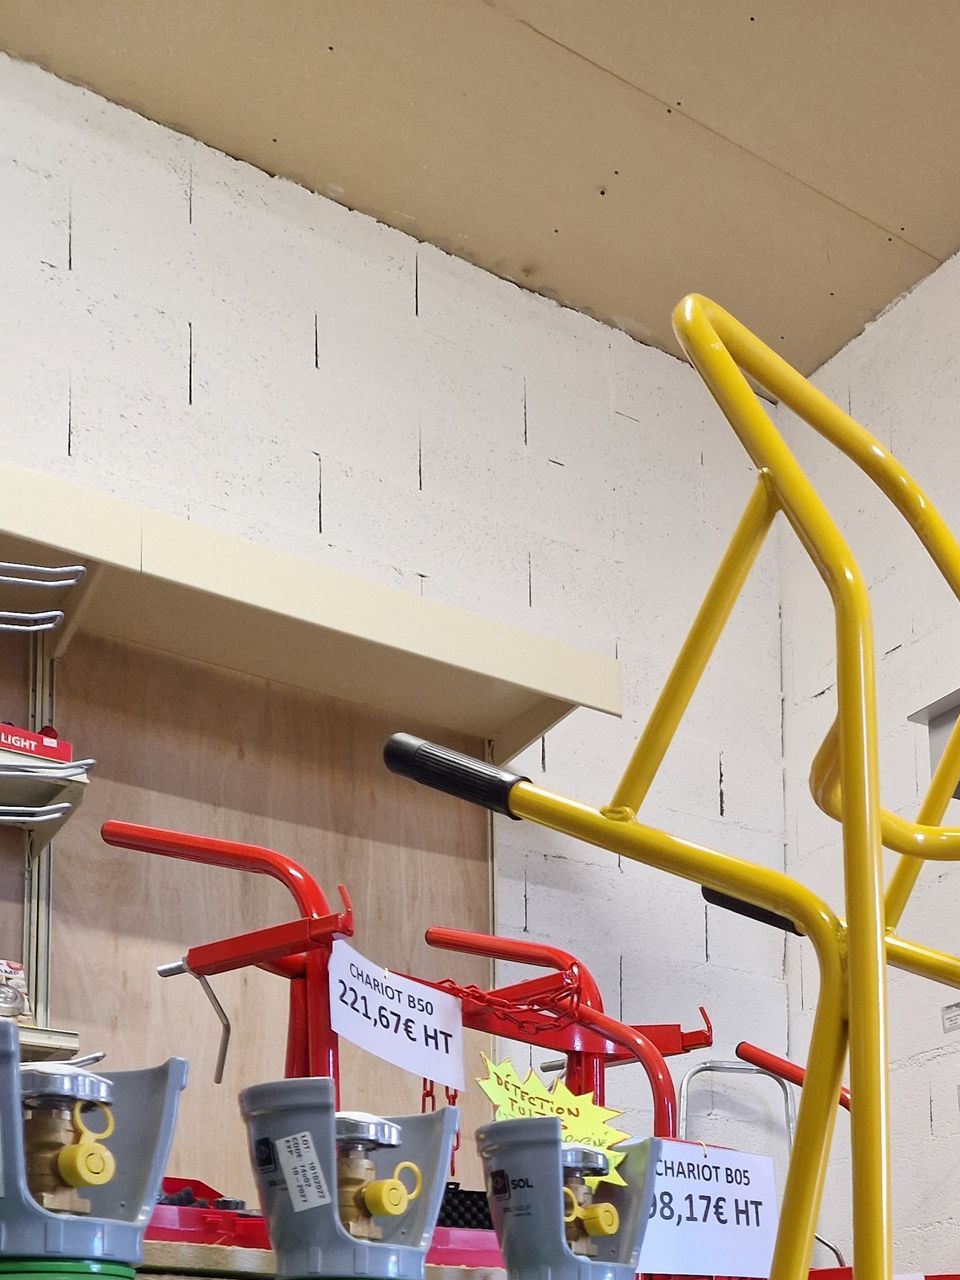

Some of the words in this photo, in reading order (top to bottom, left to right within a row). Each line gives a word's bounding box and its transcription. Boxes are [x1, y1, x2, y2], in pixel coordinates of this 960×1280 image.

[1, 732, 38, 751] LIGHT
[349, 962, 403, 1003] CHARIOT
[407, 994, 434, 1016] B50
[338, 978, 418, 1042] 221,67€
[423, 1024, 453, 1055] HT
[493, 1071, 580, 1118] DÉTECTION
[511, 1178, 534, 1190] SOL
[655, 1159, 721, 1183] CHARIOT
[725, 1167, 751, 1186] B05
[734, 1198, 763, 1228] HT
